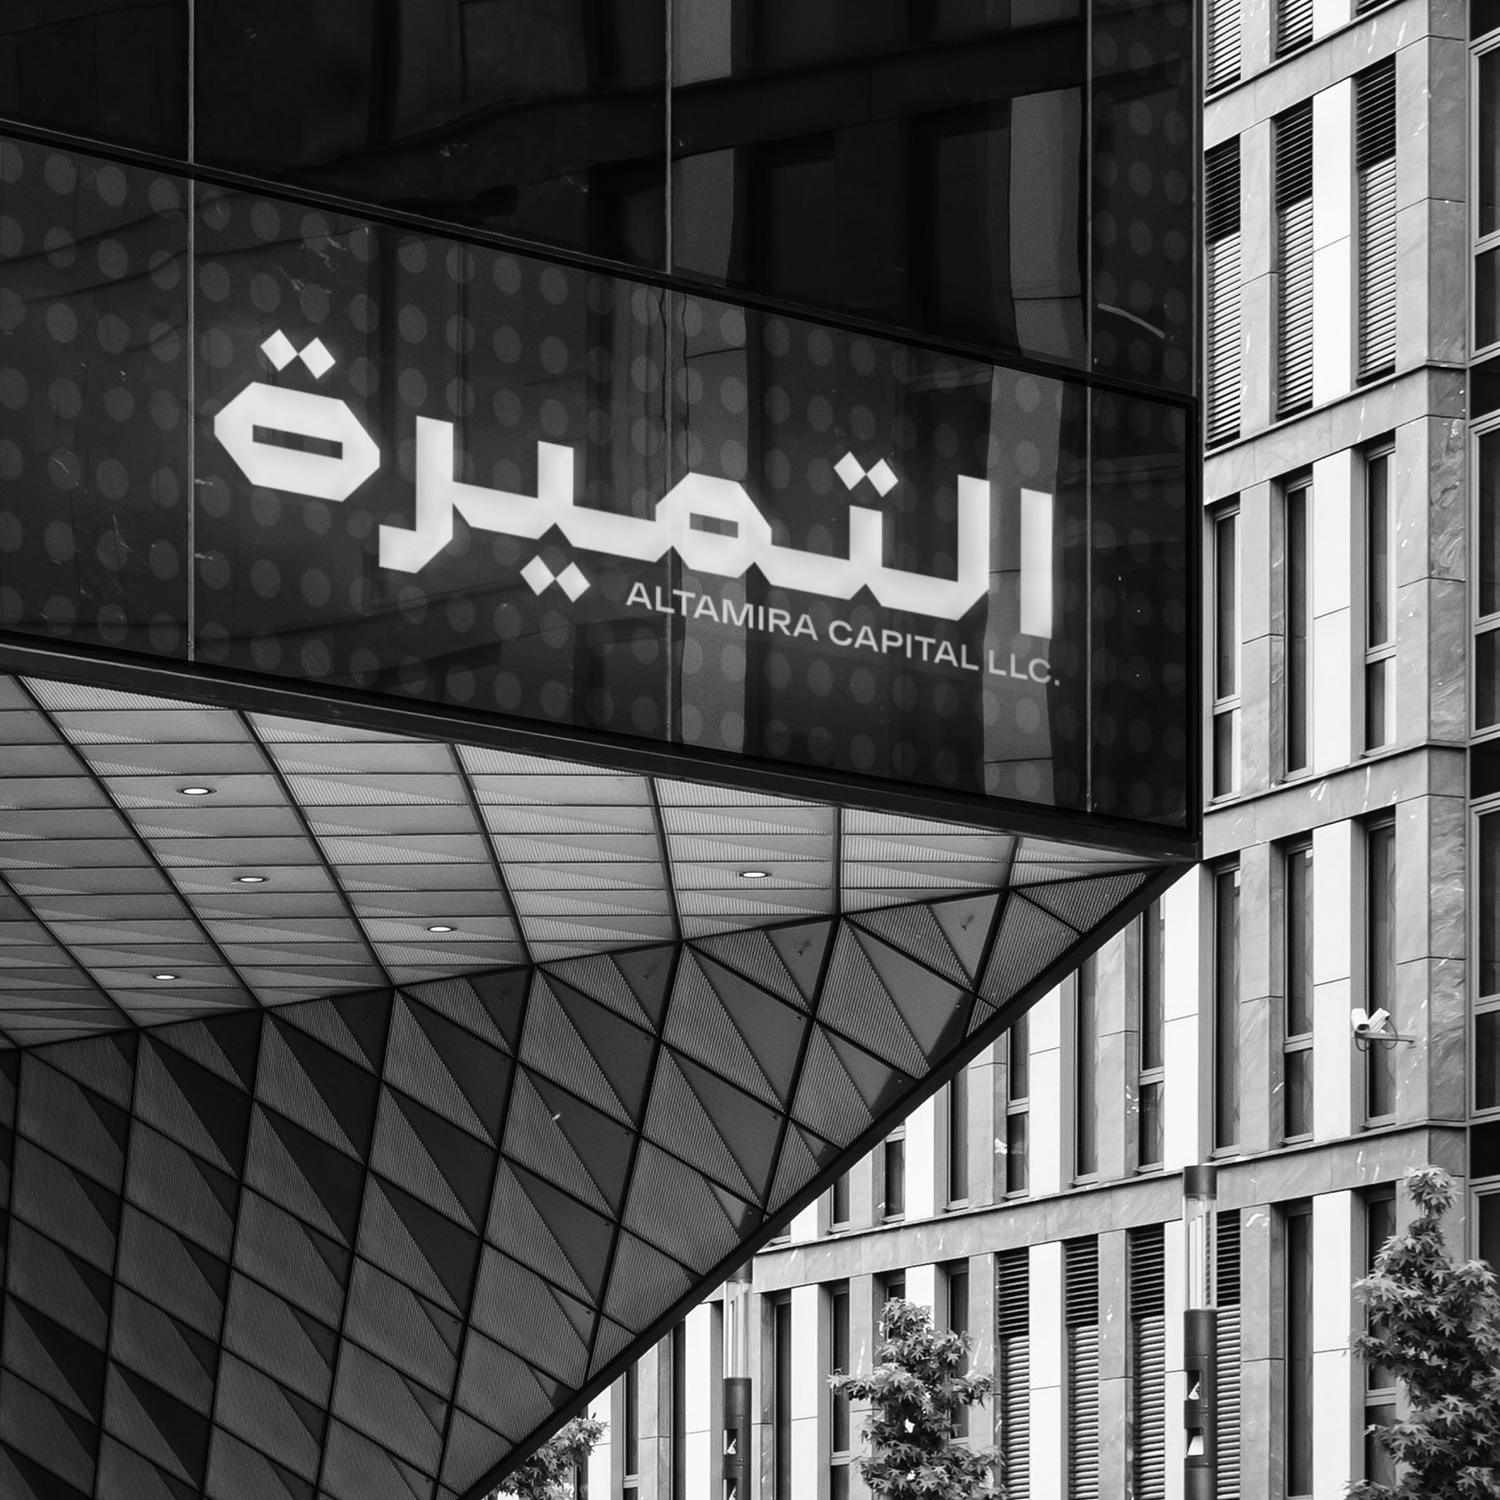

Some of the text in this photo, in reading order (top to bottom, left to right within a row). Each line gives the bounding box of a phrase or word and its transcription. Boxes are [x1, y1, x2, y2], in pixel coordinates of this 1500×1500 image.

[213, 329, 1053, 639] التميرة
[625, 582, 1060, 687] ALTAMIRA CAPITAL LLC.
